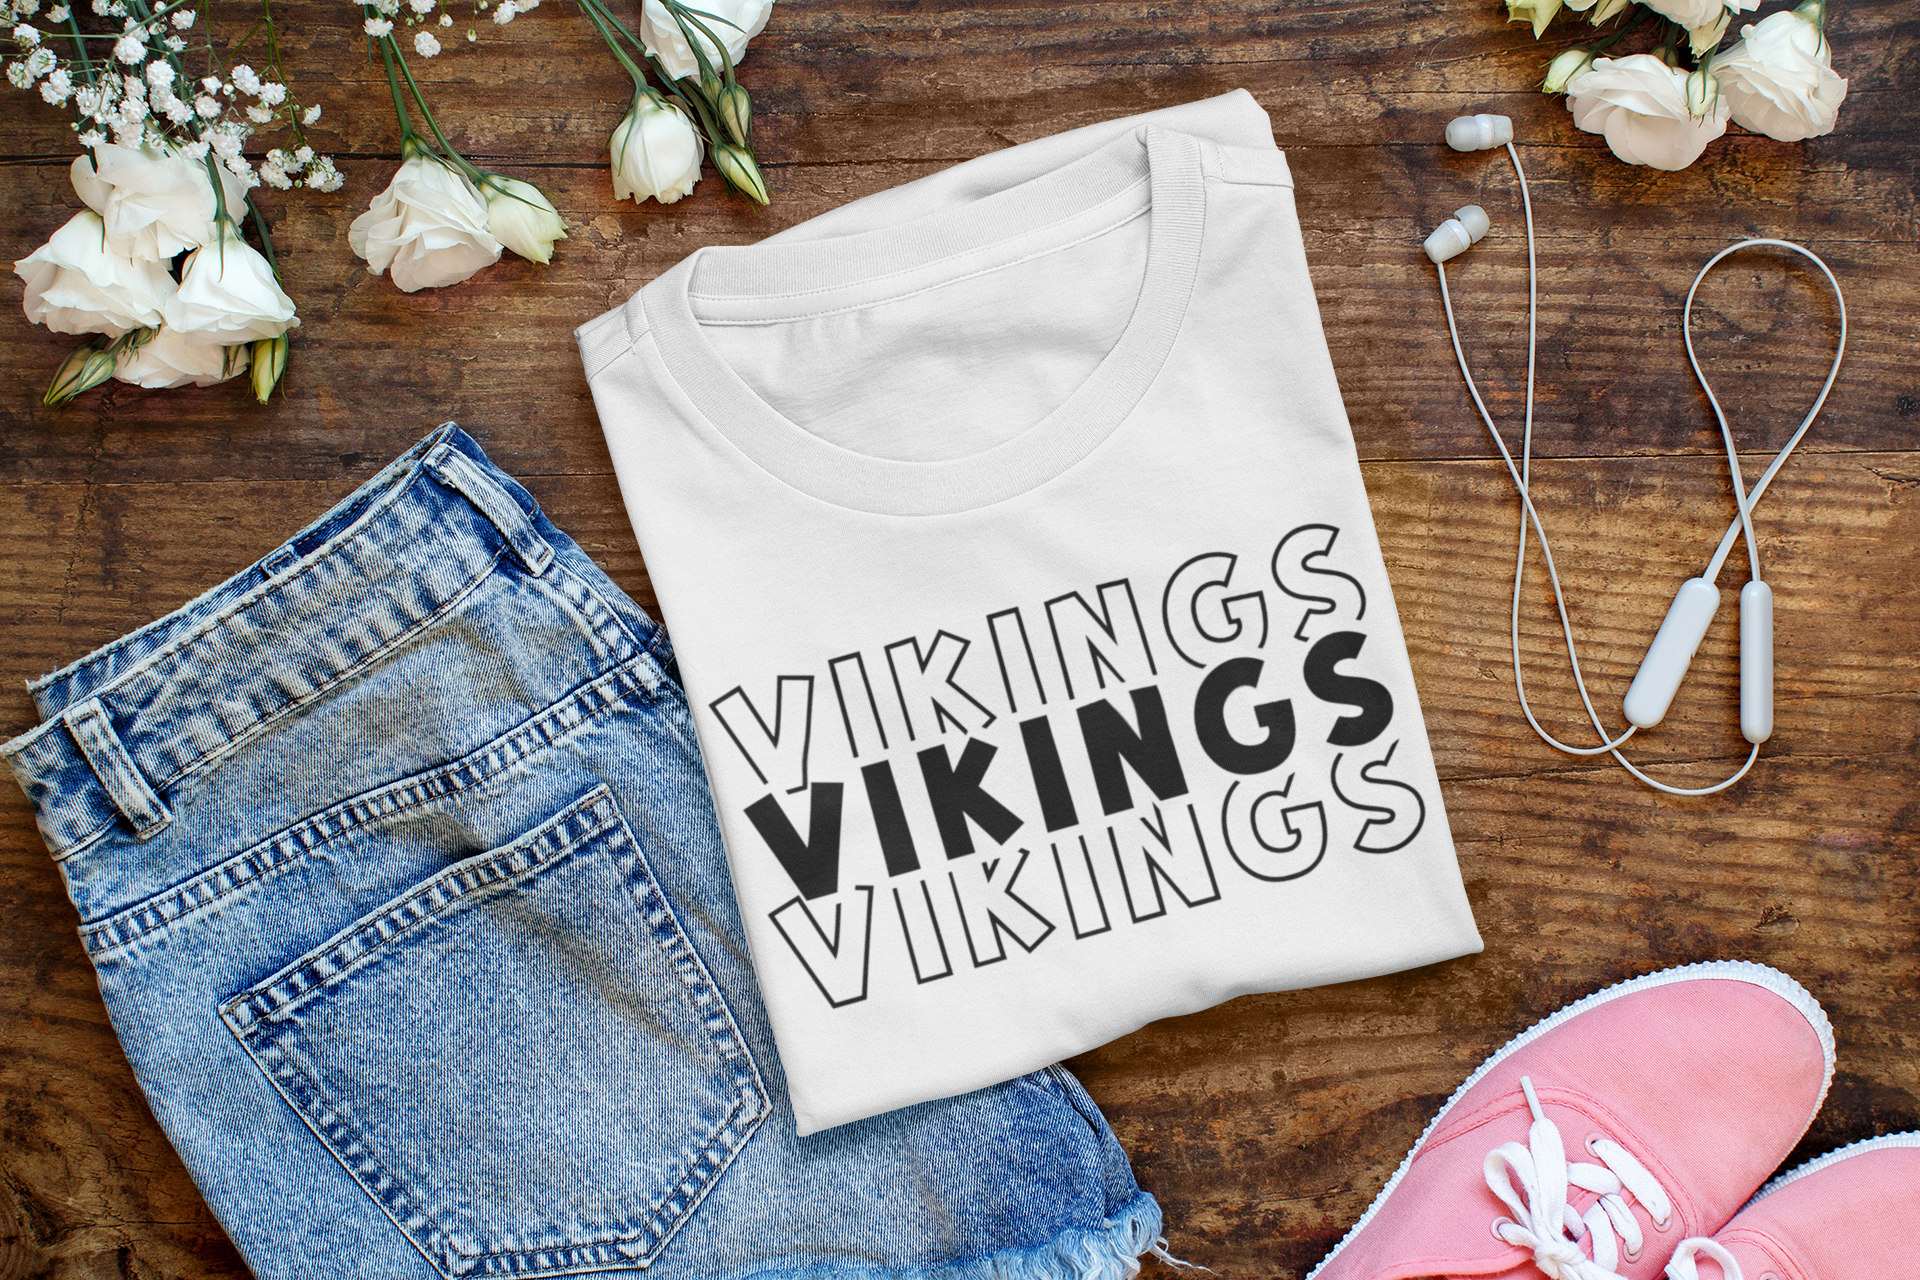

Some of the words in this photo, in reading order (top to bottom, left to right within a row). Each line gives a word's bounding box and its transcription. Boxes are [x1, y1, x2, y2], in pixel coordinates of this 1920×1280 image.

[709, 524, 1367, 795] VIKINGS
[743, 631, 1394, 901] VIKINGS
[768, 738, 1426, 1009] VIKINGS
